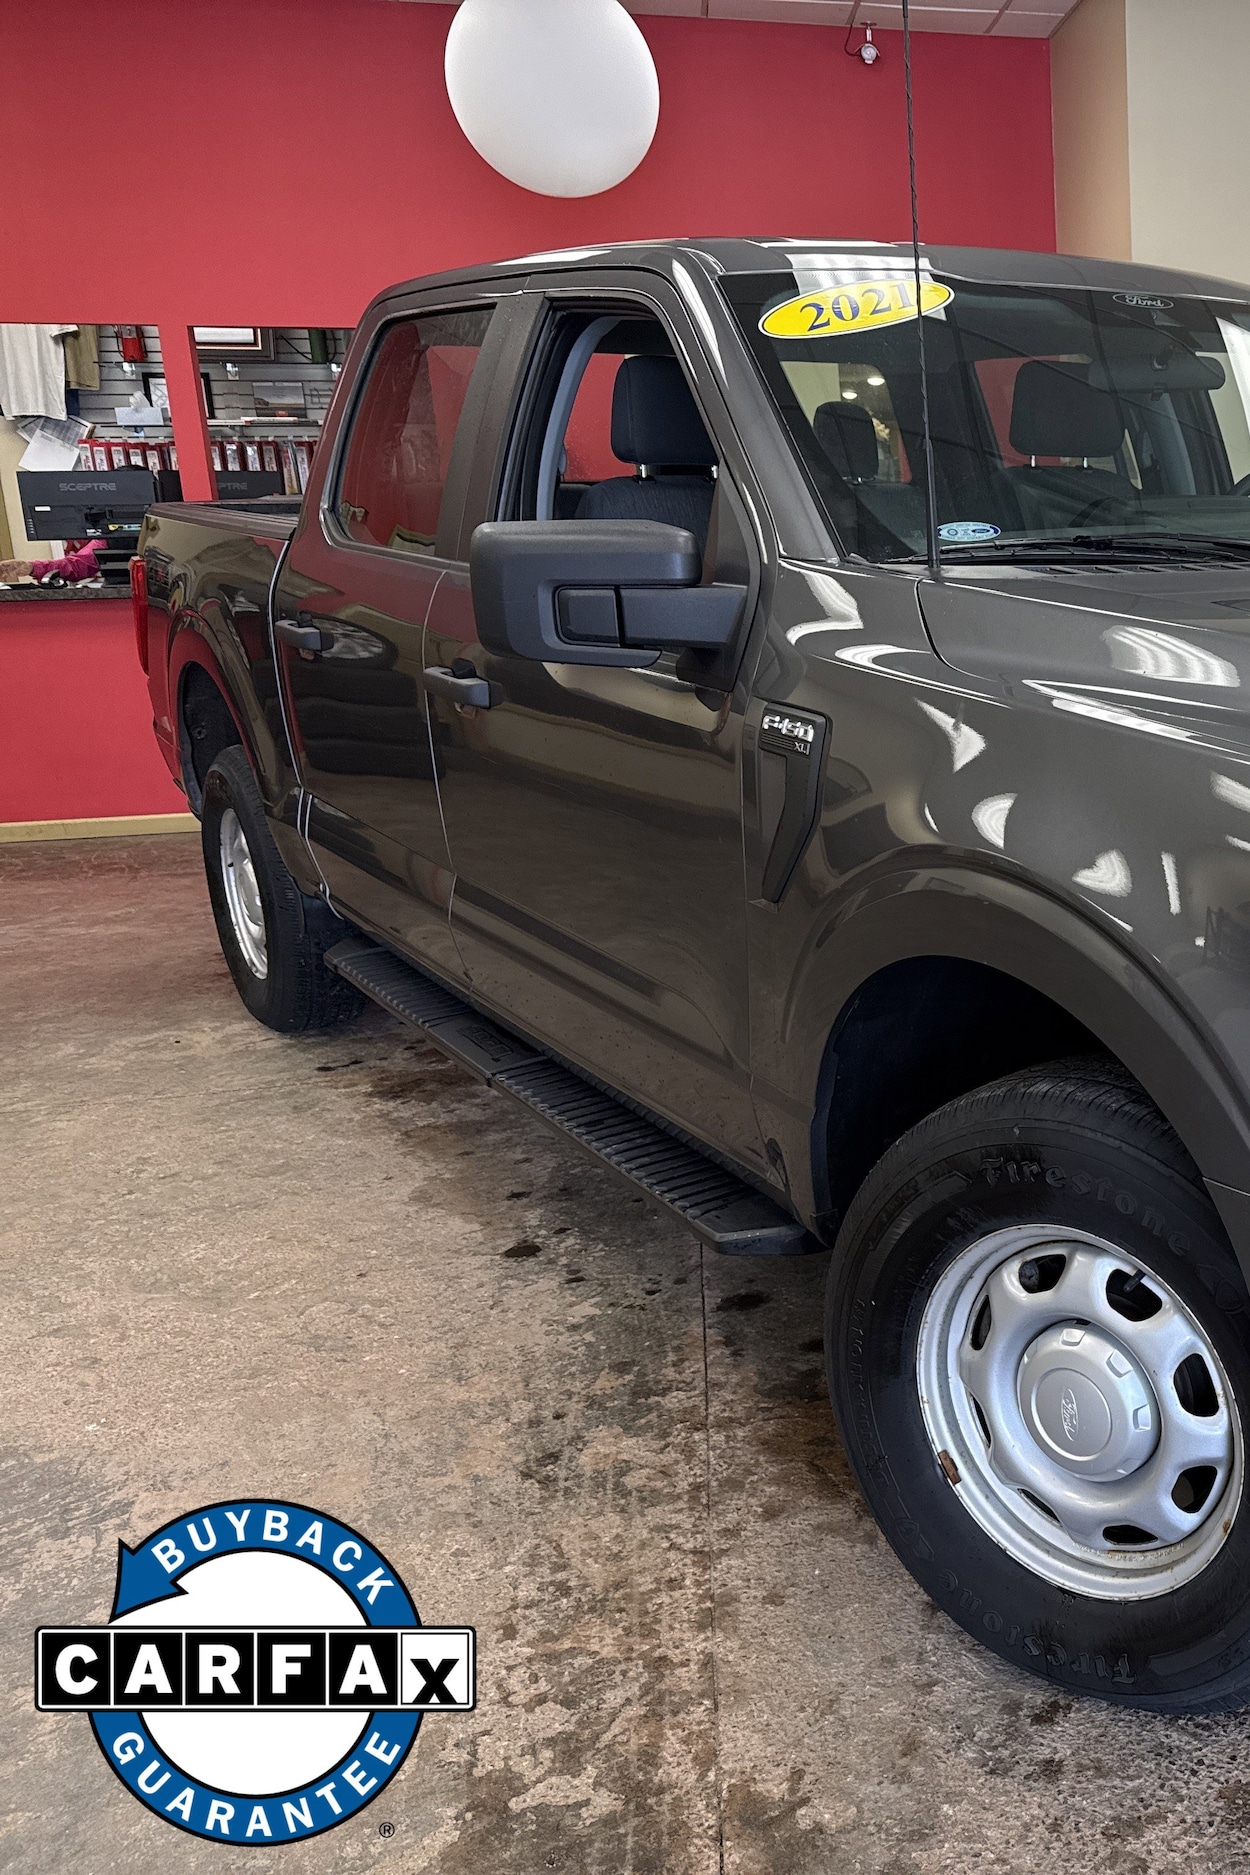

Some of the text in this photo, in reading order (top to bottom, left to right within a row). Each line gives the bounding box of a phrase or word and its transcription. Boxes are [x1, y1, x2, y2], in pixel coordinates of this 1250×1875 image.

[799, 282, 915, 333] 2021
[1125, 295, 1164, 307] Ford
[58, 482, 117, 492] SCEPTRE
[762, 715, 814, 742] F-150
[979, 1157, 1192, 1256] Firestone
